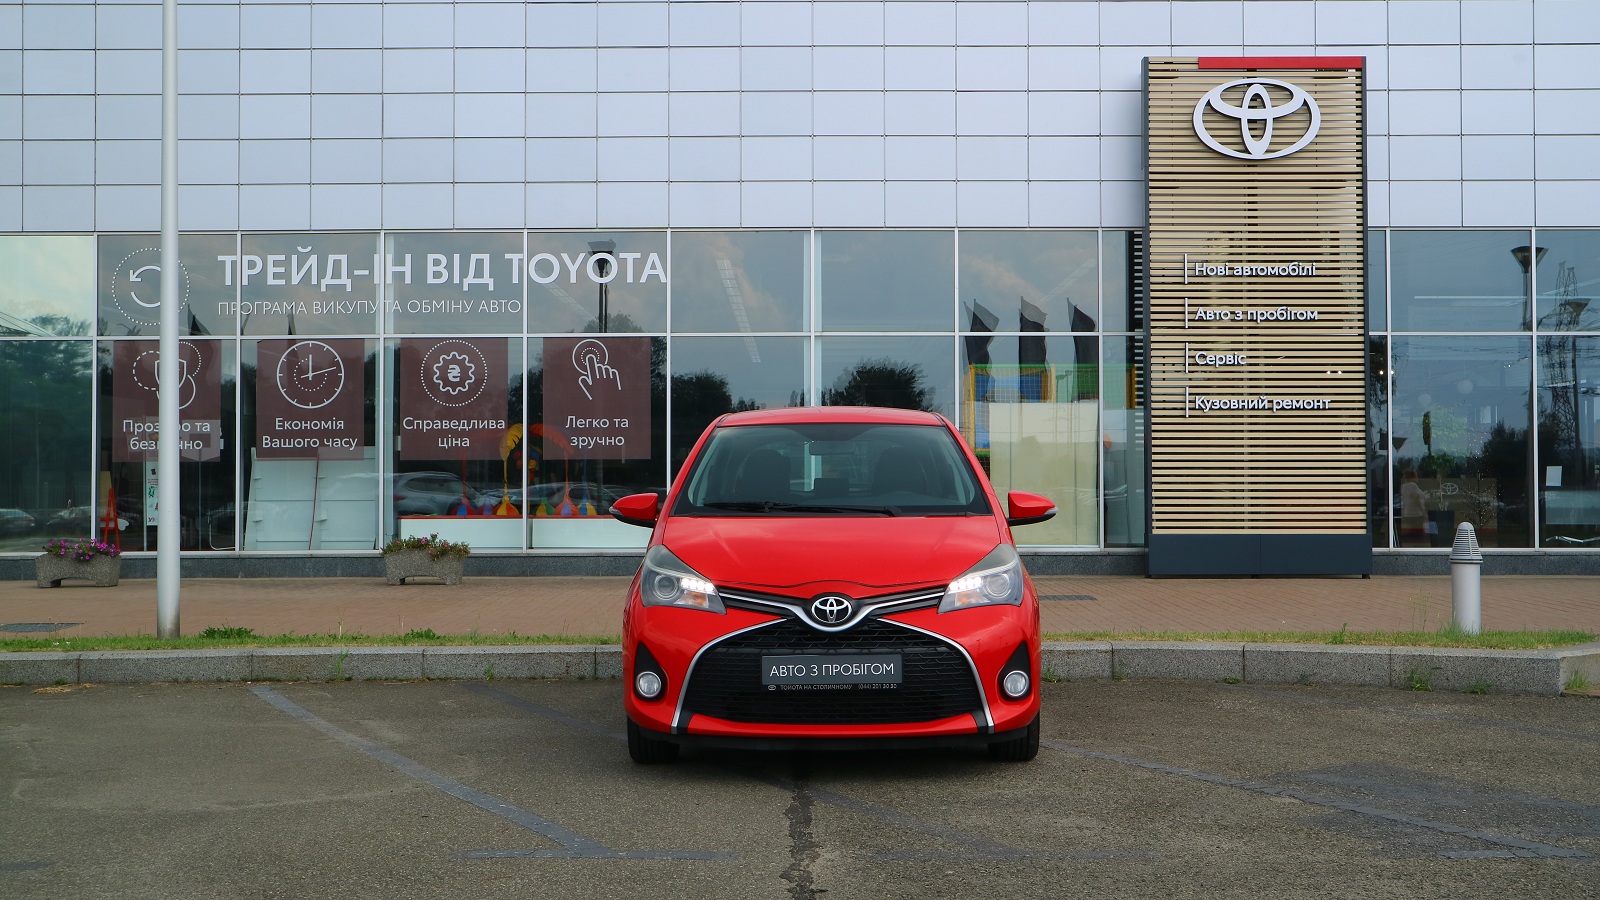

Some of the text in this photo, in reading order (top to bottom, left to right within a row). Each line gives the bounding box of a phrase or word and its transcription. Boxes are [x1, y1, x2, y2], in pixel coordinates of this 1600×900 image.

[217, 246, 667, 292] ТРЕЙД-ІН ВІД TOYOTA
[1195, 261, 1316, 276] Нові автомобілі
[218, 299, 521, 315] ПРОГРАМА ВИКУПУ ТА ОБМІНУ АВТО
[1195, 306, 1318, 323] Авто з пробігом
[1195, 351, 1247, 368] Сервіс
[1195, 395, 1331, 412] Кузовний ремонт
[123, 419, 210, 435] Прозо та
[275, 417, 345, 430] Економія
[403, 417, 505, 432] Справедлива
[565, 416, 629, 429] Легко та
[130, 436, 203, 450] безно
[262, 436, 358, 450] Вашого часу
[438, 435, 470, 449] ціна
[570, 435, 625, 449] зручно
[769, 663, 894, 677] АВТО З ПРОБІГОМ
